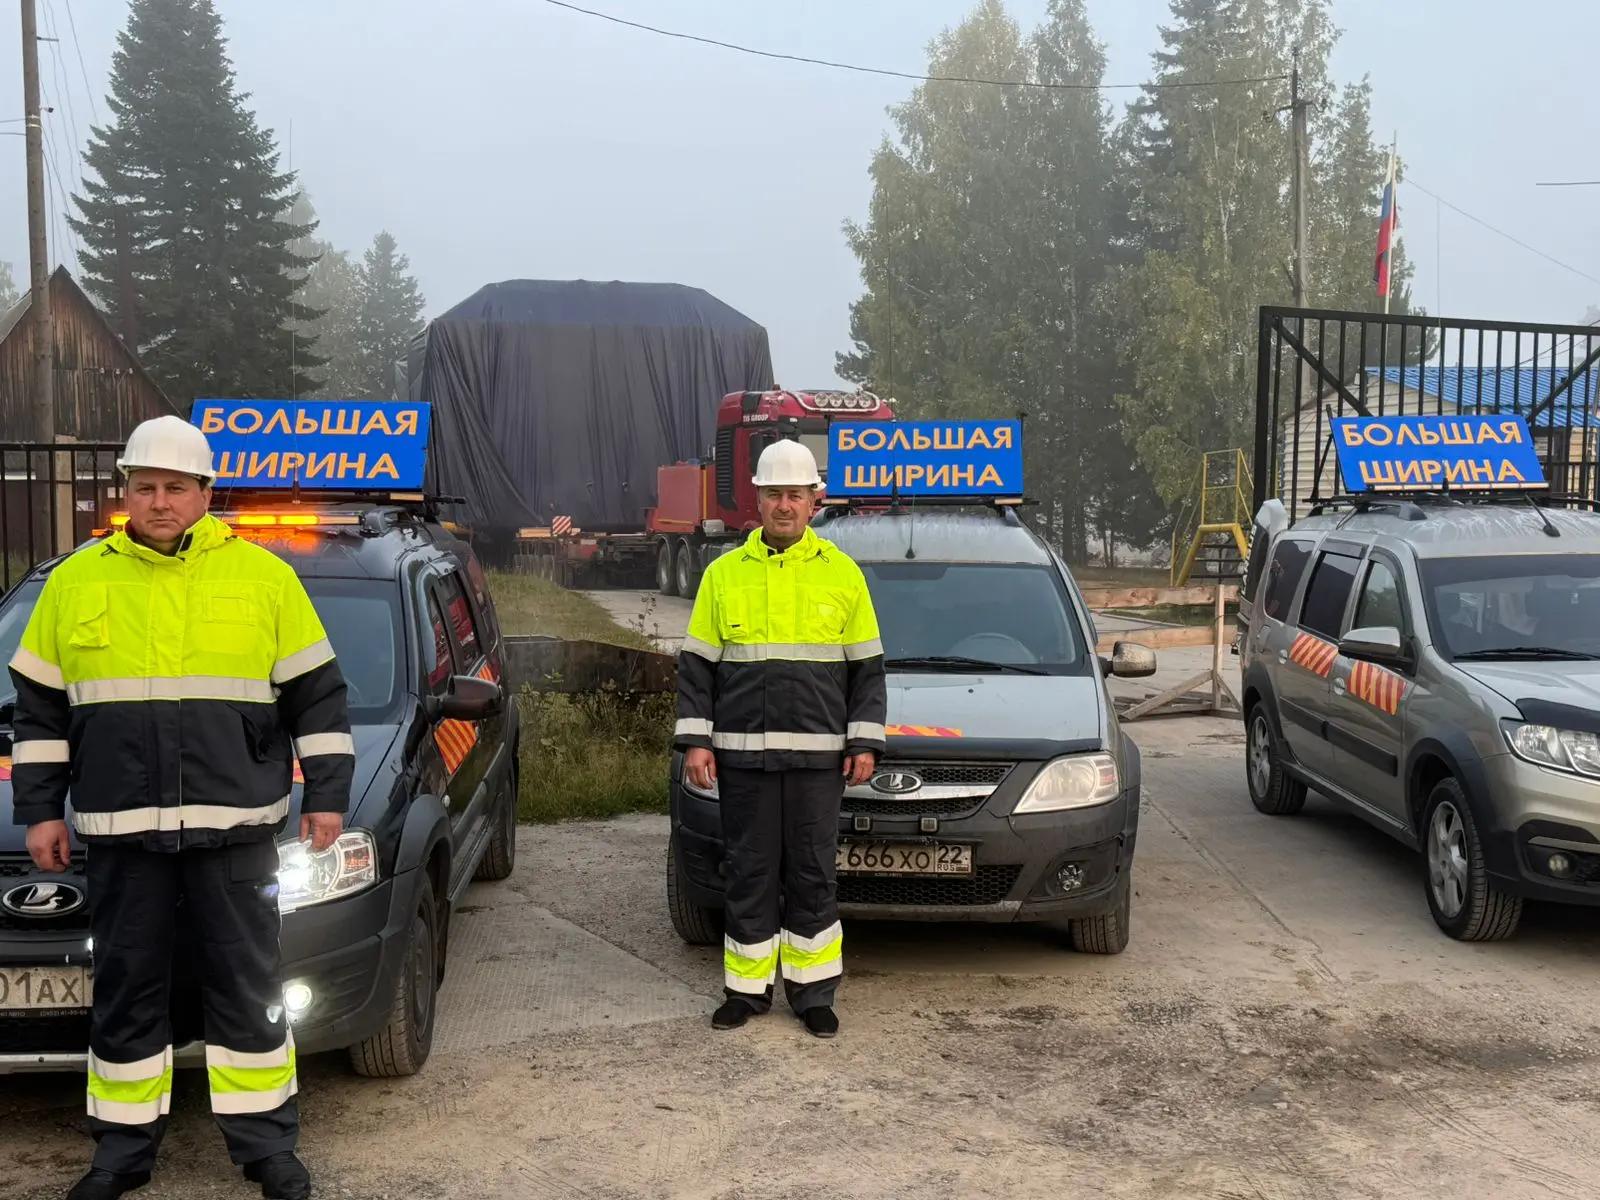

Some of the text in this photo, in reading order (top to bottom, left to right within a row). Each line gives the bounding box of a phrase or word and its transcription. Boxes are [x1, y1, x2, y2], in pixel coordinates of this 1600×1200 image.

[201, 407, 418, 436] БОЛЬШАЯ
[1341, 421, 1522, 446] БОЛЬШАЯ
[838, 427, 1012, 451] БОЛЬШАЯ
[211, 452, 399, 479] ШИРИНА
[844, 464, 1004, 487] ШИРИНА
[1359, 459, 1525, 483] ШИРИНА
[938, 846, 963, 864] 22
